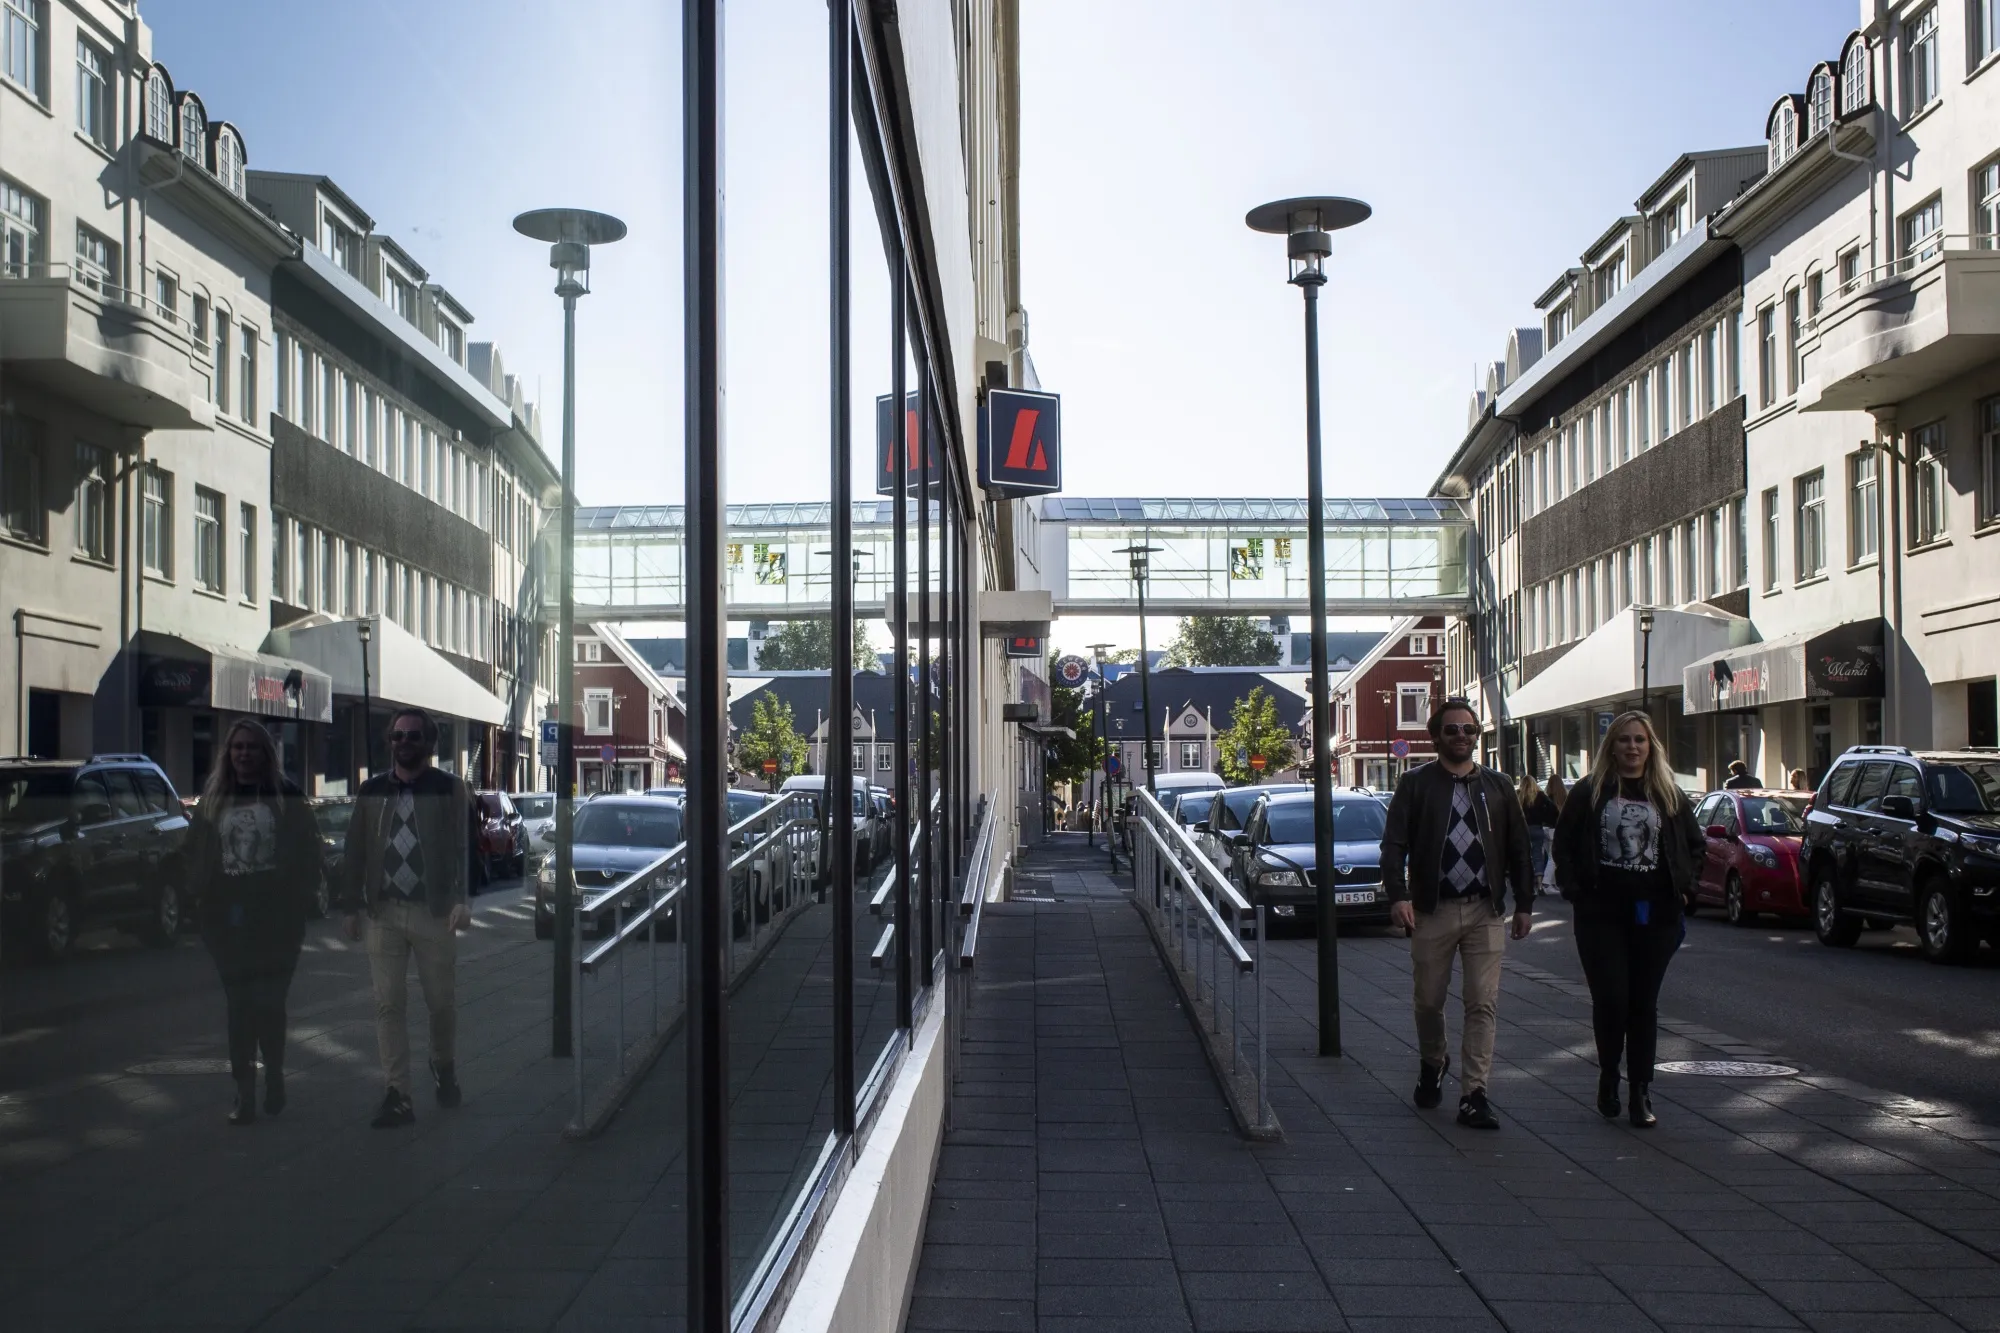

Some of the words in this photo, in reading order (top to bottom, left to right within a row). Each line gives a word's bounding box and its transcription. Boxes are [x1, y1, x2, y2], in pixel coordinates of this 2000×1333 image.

[1057, 655, 1087, 671] ICEWEAR
[1822, 661, 1871, 677] Mandi
[1732, 667, 1760, 695] PIZZA
[1352, 892, 1374, 902] 516
